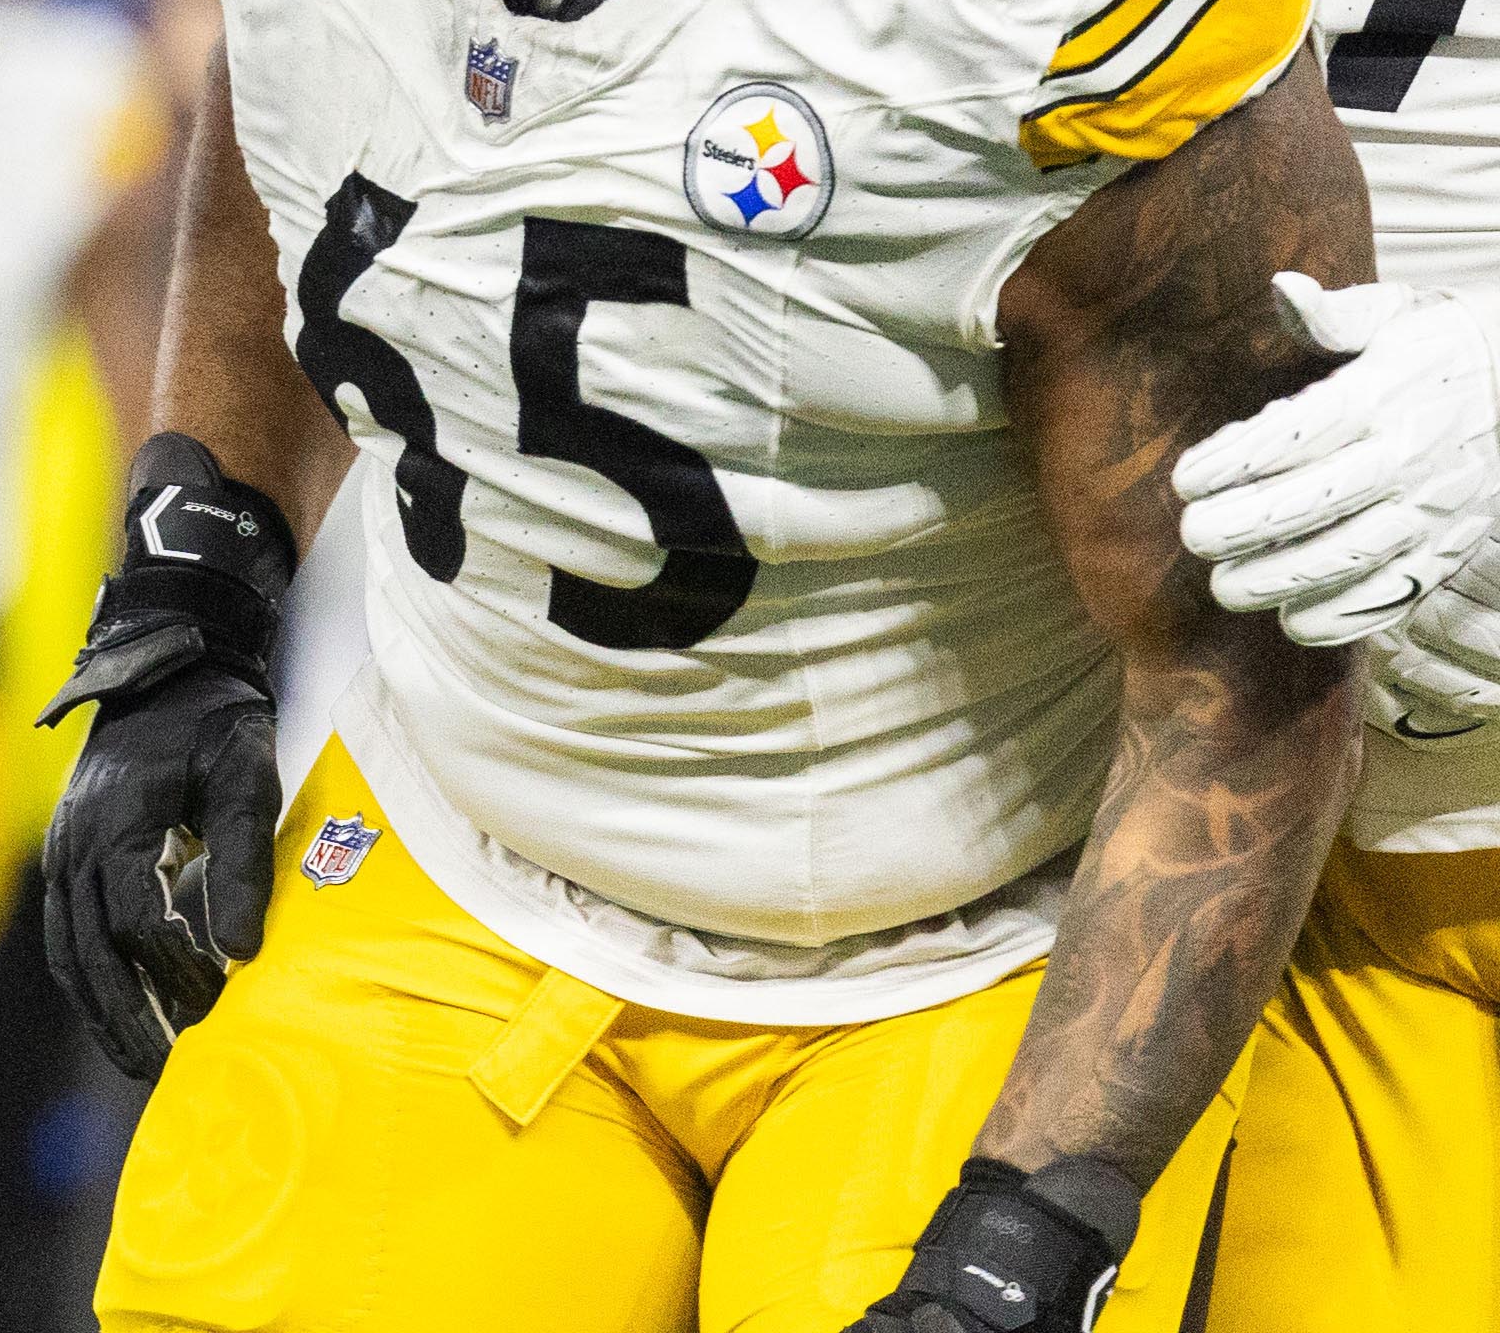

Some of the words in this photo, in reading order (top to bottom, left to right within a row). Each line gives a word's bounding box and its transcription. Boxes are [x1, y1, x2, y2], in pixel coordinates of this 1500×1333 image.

[702, 139, 757, 171] Steelers
[296, 170, 760, 650] 65
[309, 842, 352, 874] NFL
